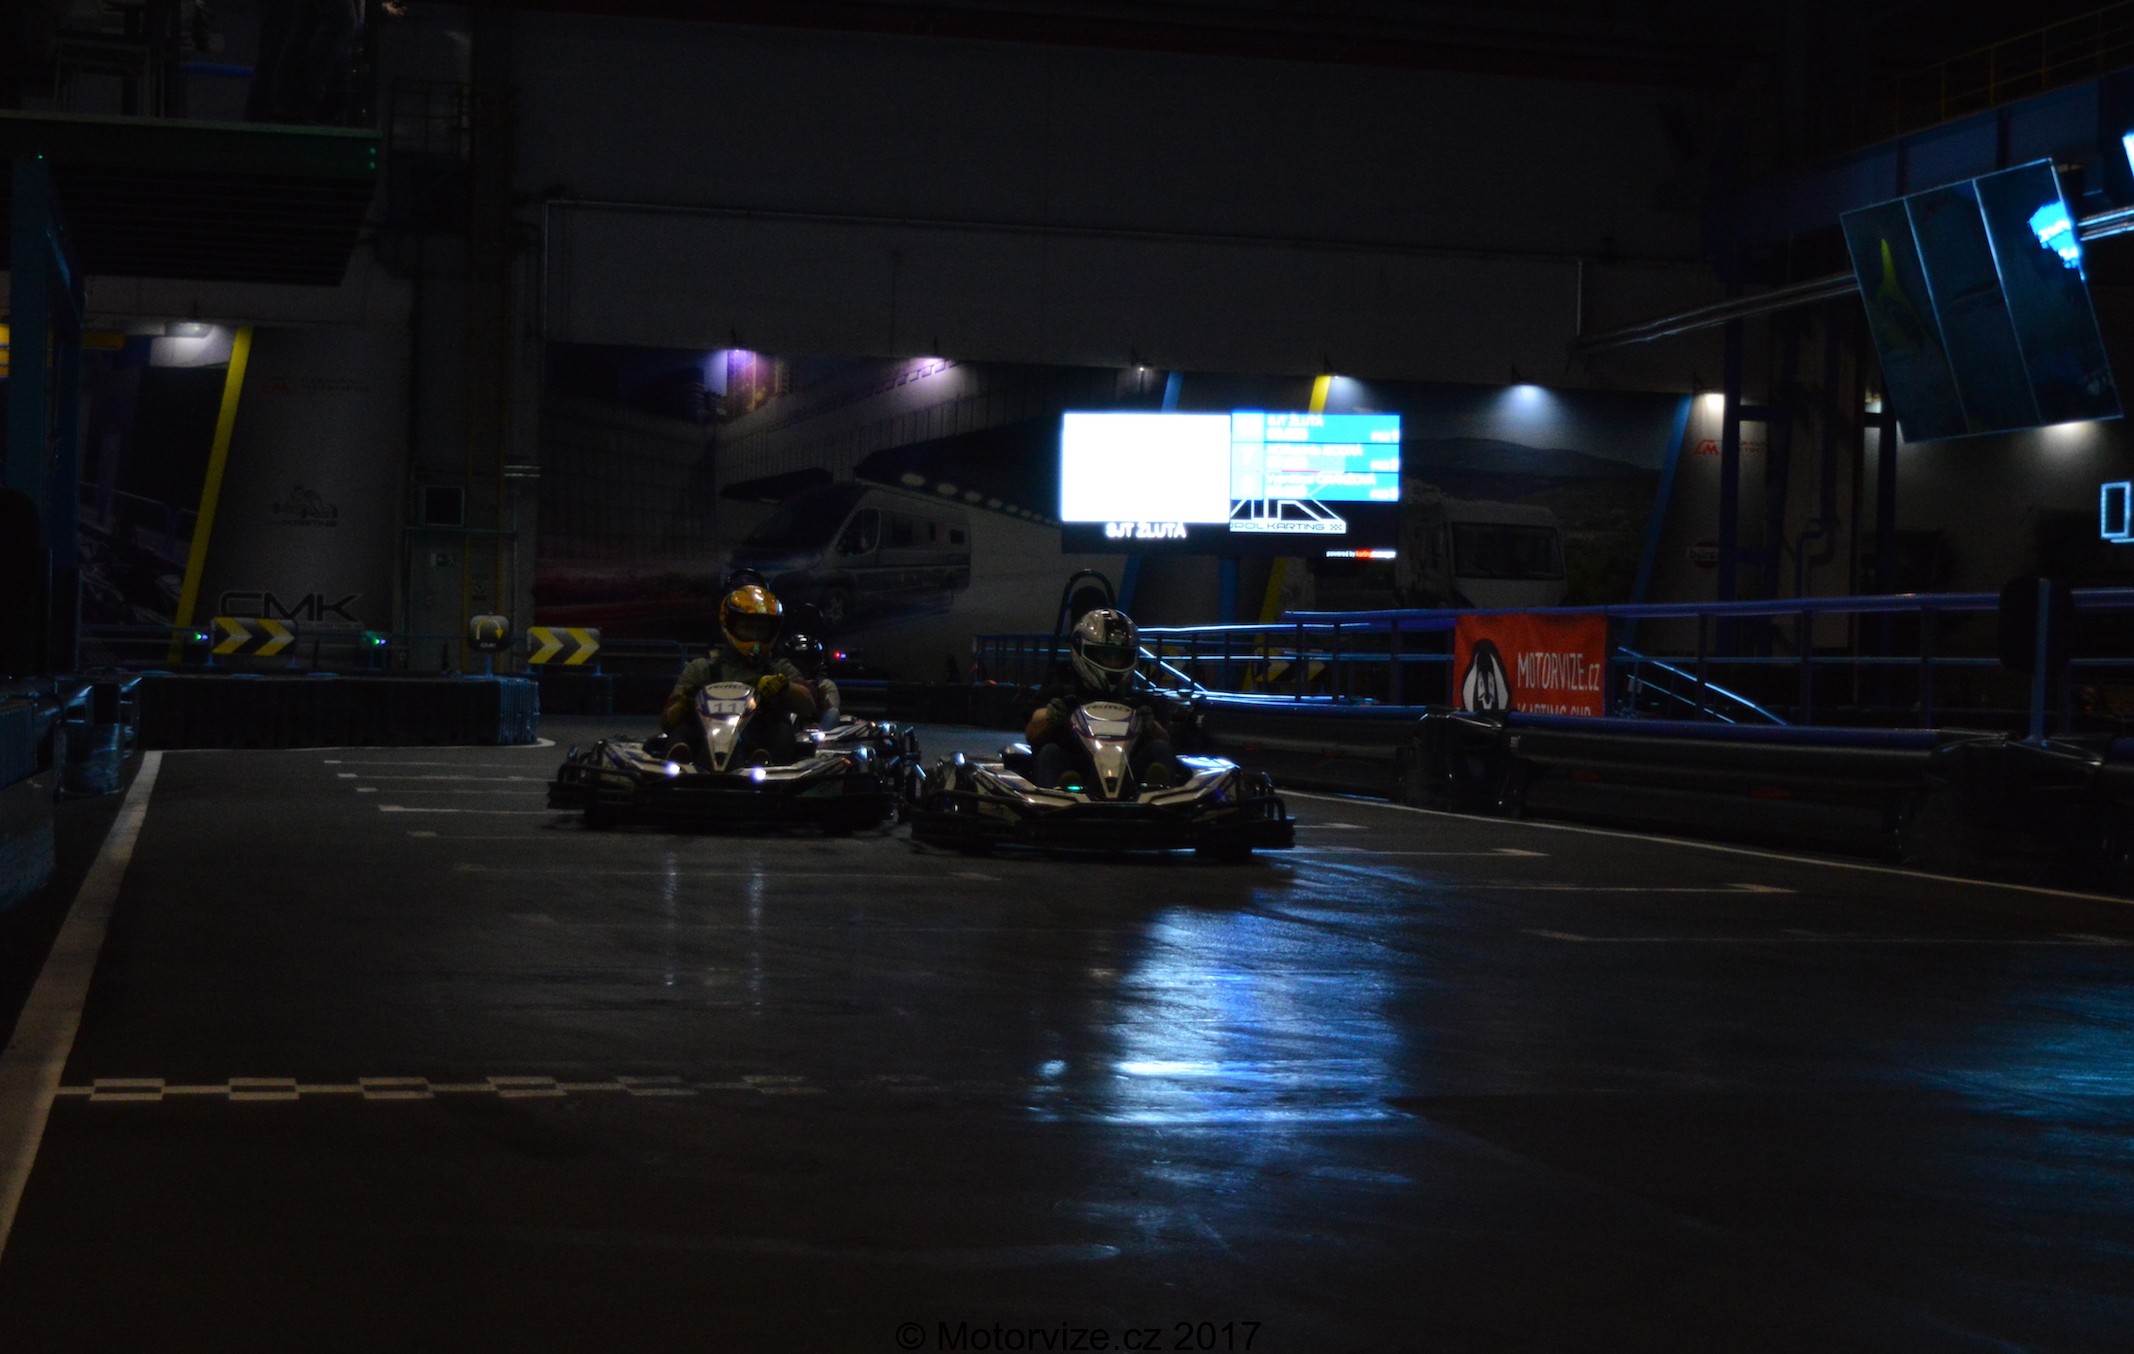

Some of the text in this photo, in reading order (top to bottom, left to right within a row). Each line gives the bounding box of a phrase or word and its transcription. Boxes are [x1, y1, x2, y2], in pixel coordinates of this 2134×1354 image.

[1267, 522, 1325, 531] KARTING
[221, 591, 360, 621] CMK
[1517, 652, 1600, 692] MOTORVIZE.cz
[713, 702, 736, 713] 11
